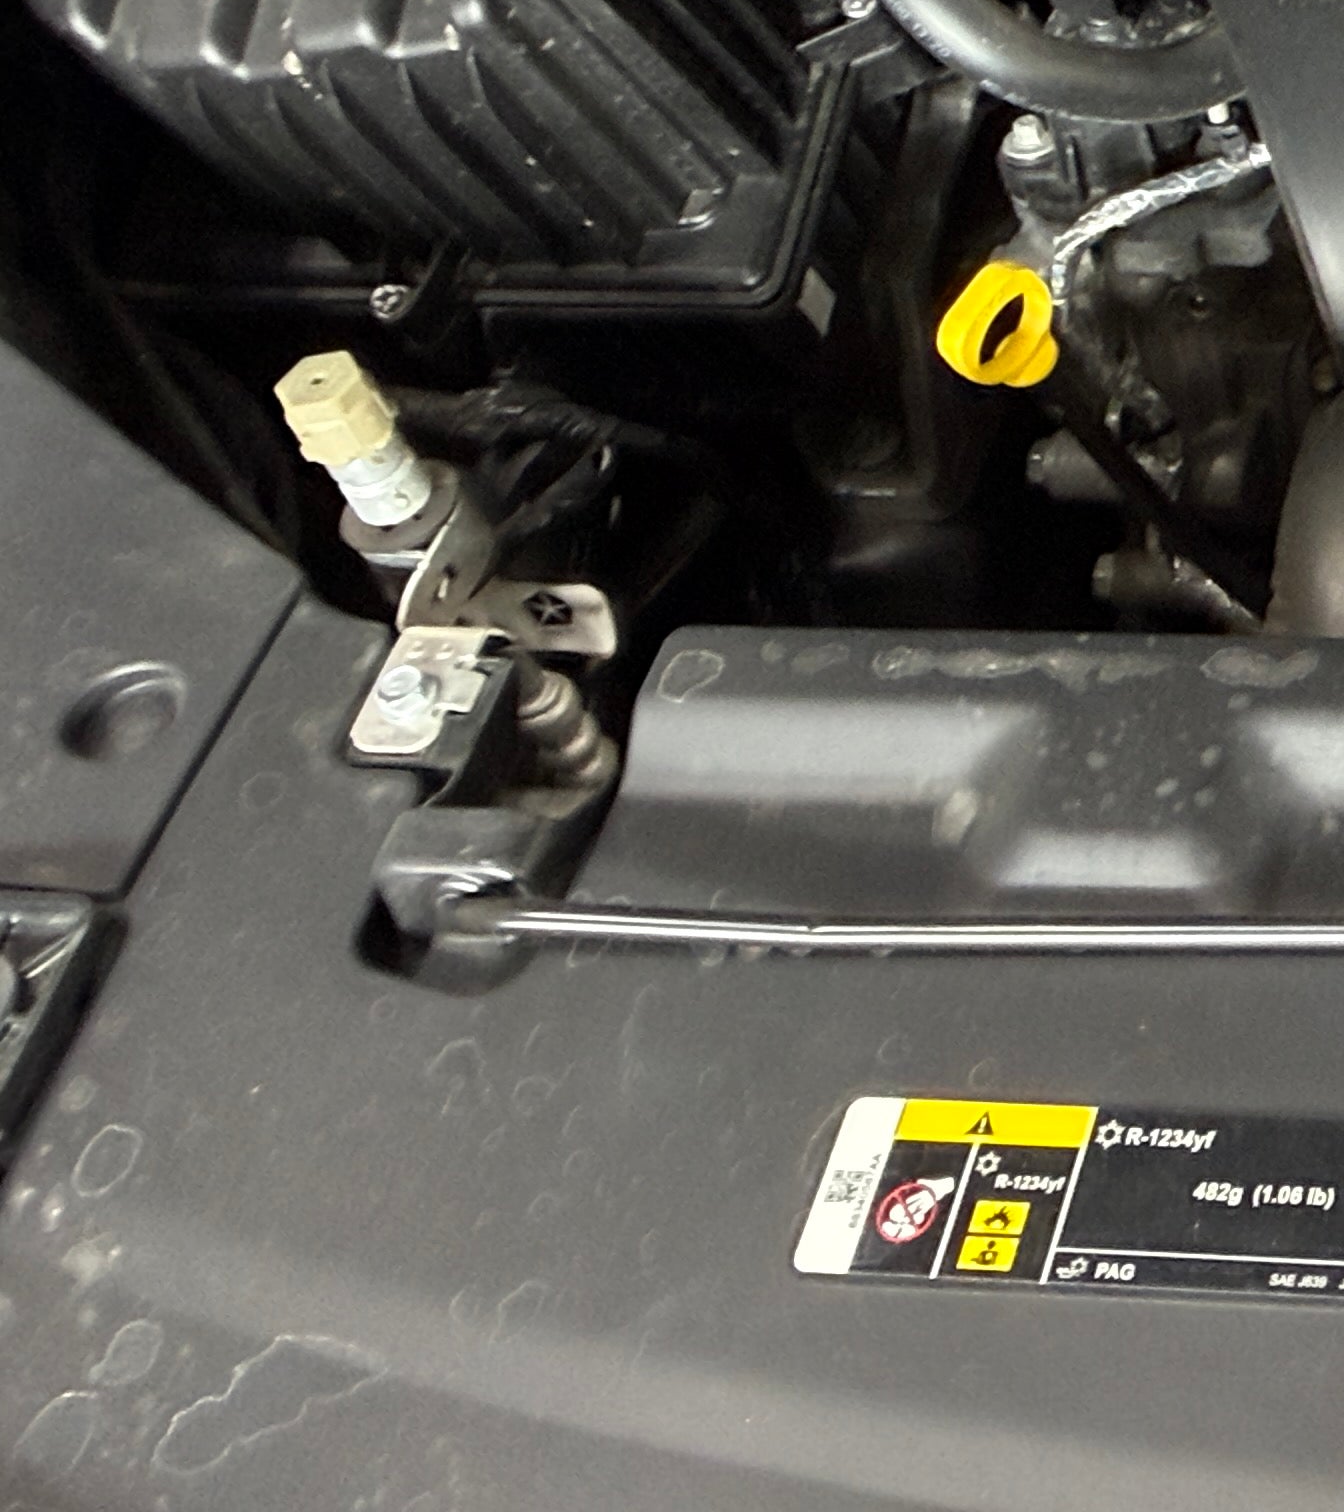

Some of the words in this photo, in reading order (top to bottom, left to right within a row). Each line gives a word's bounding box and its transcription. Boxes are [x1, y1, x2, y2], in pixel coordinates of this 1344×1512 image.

[1124, 1127, 1218, 1153] R-1234yf
[994, 1174, 1066, 1194] R-1234yf
[1192, 1181, 1244, 1207] 482g
[1252, 1184, 1304, 1208] (1.06
[1306, 1187, 1335, 1211] lb)
[1094, 1262, 1136, 1281] PAG
[1268, 1273, 1297, 1288] SAE
